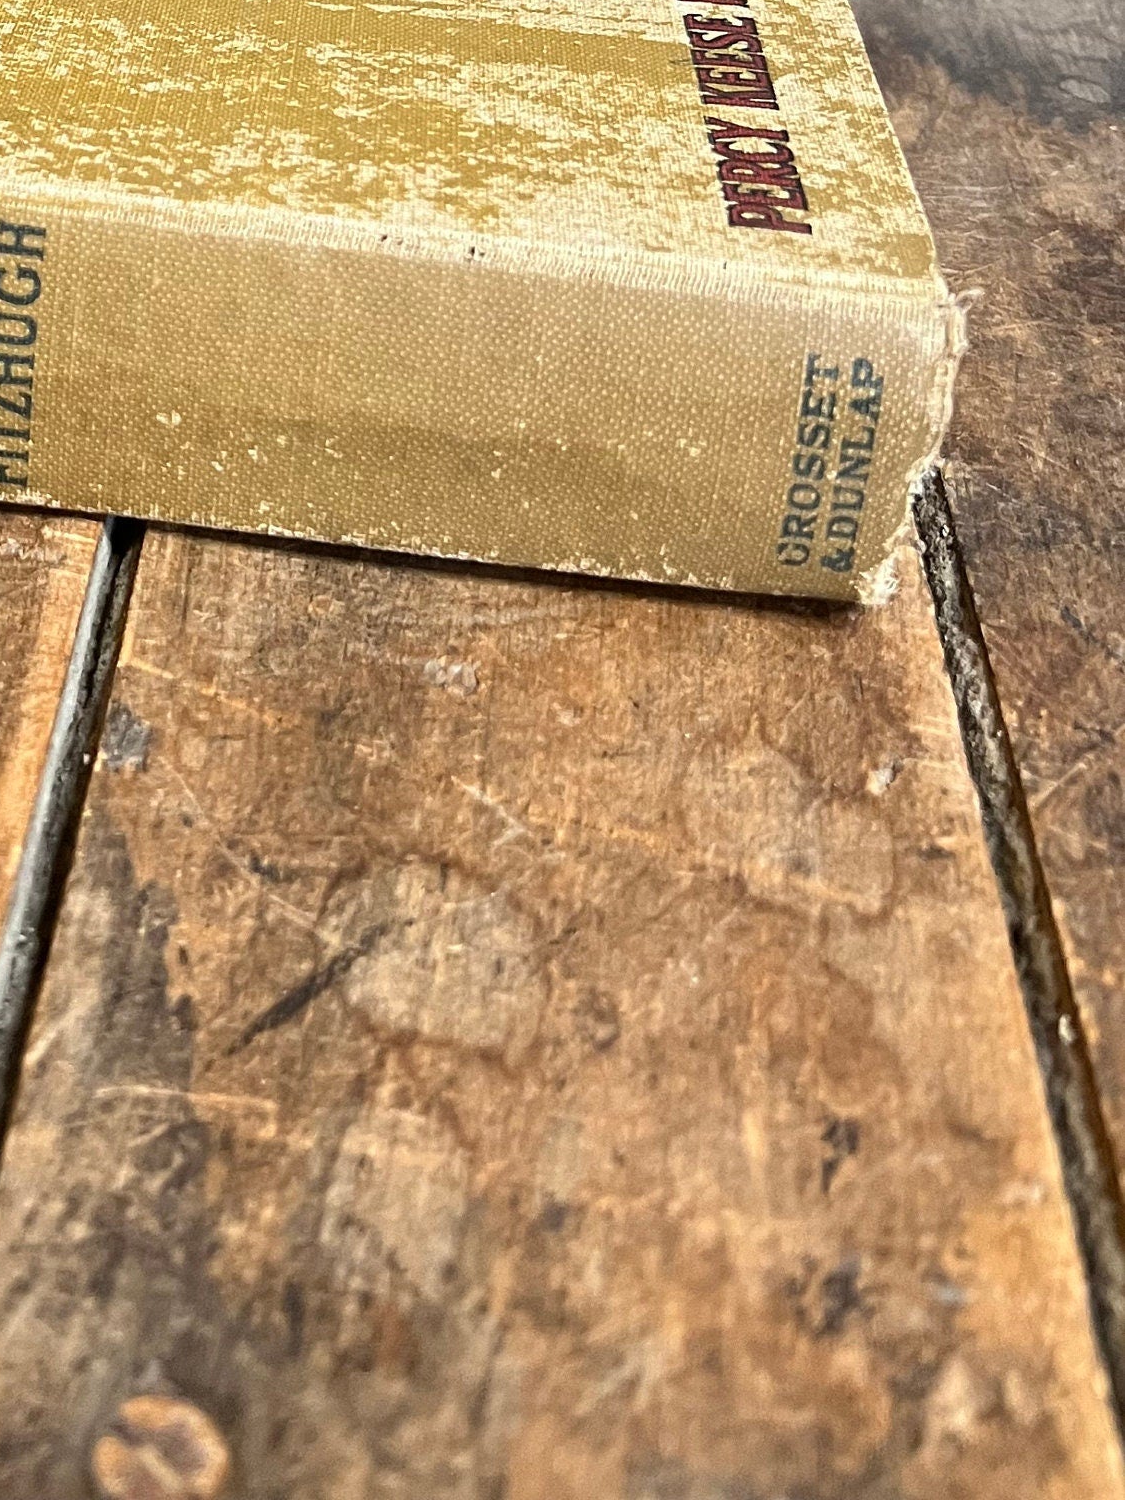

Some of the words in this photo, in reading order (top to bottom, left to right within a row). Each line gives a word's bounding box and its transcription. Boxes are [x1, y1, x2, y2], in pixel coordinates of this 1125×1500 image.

[683, 6, 780, 111] KEESE
[703, 115, 813, 235] PERCY
[776, 353, 840, 567] GROSSET
